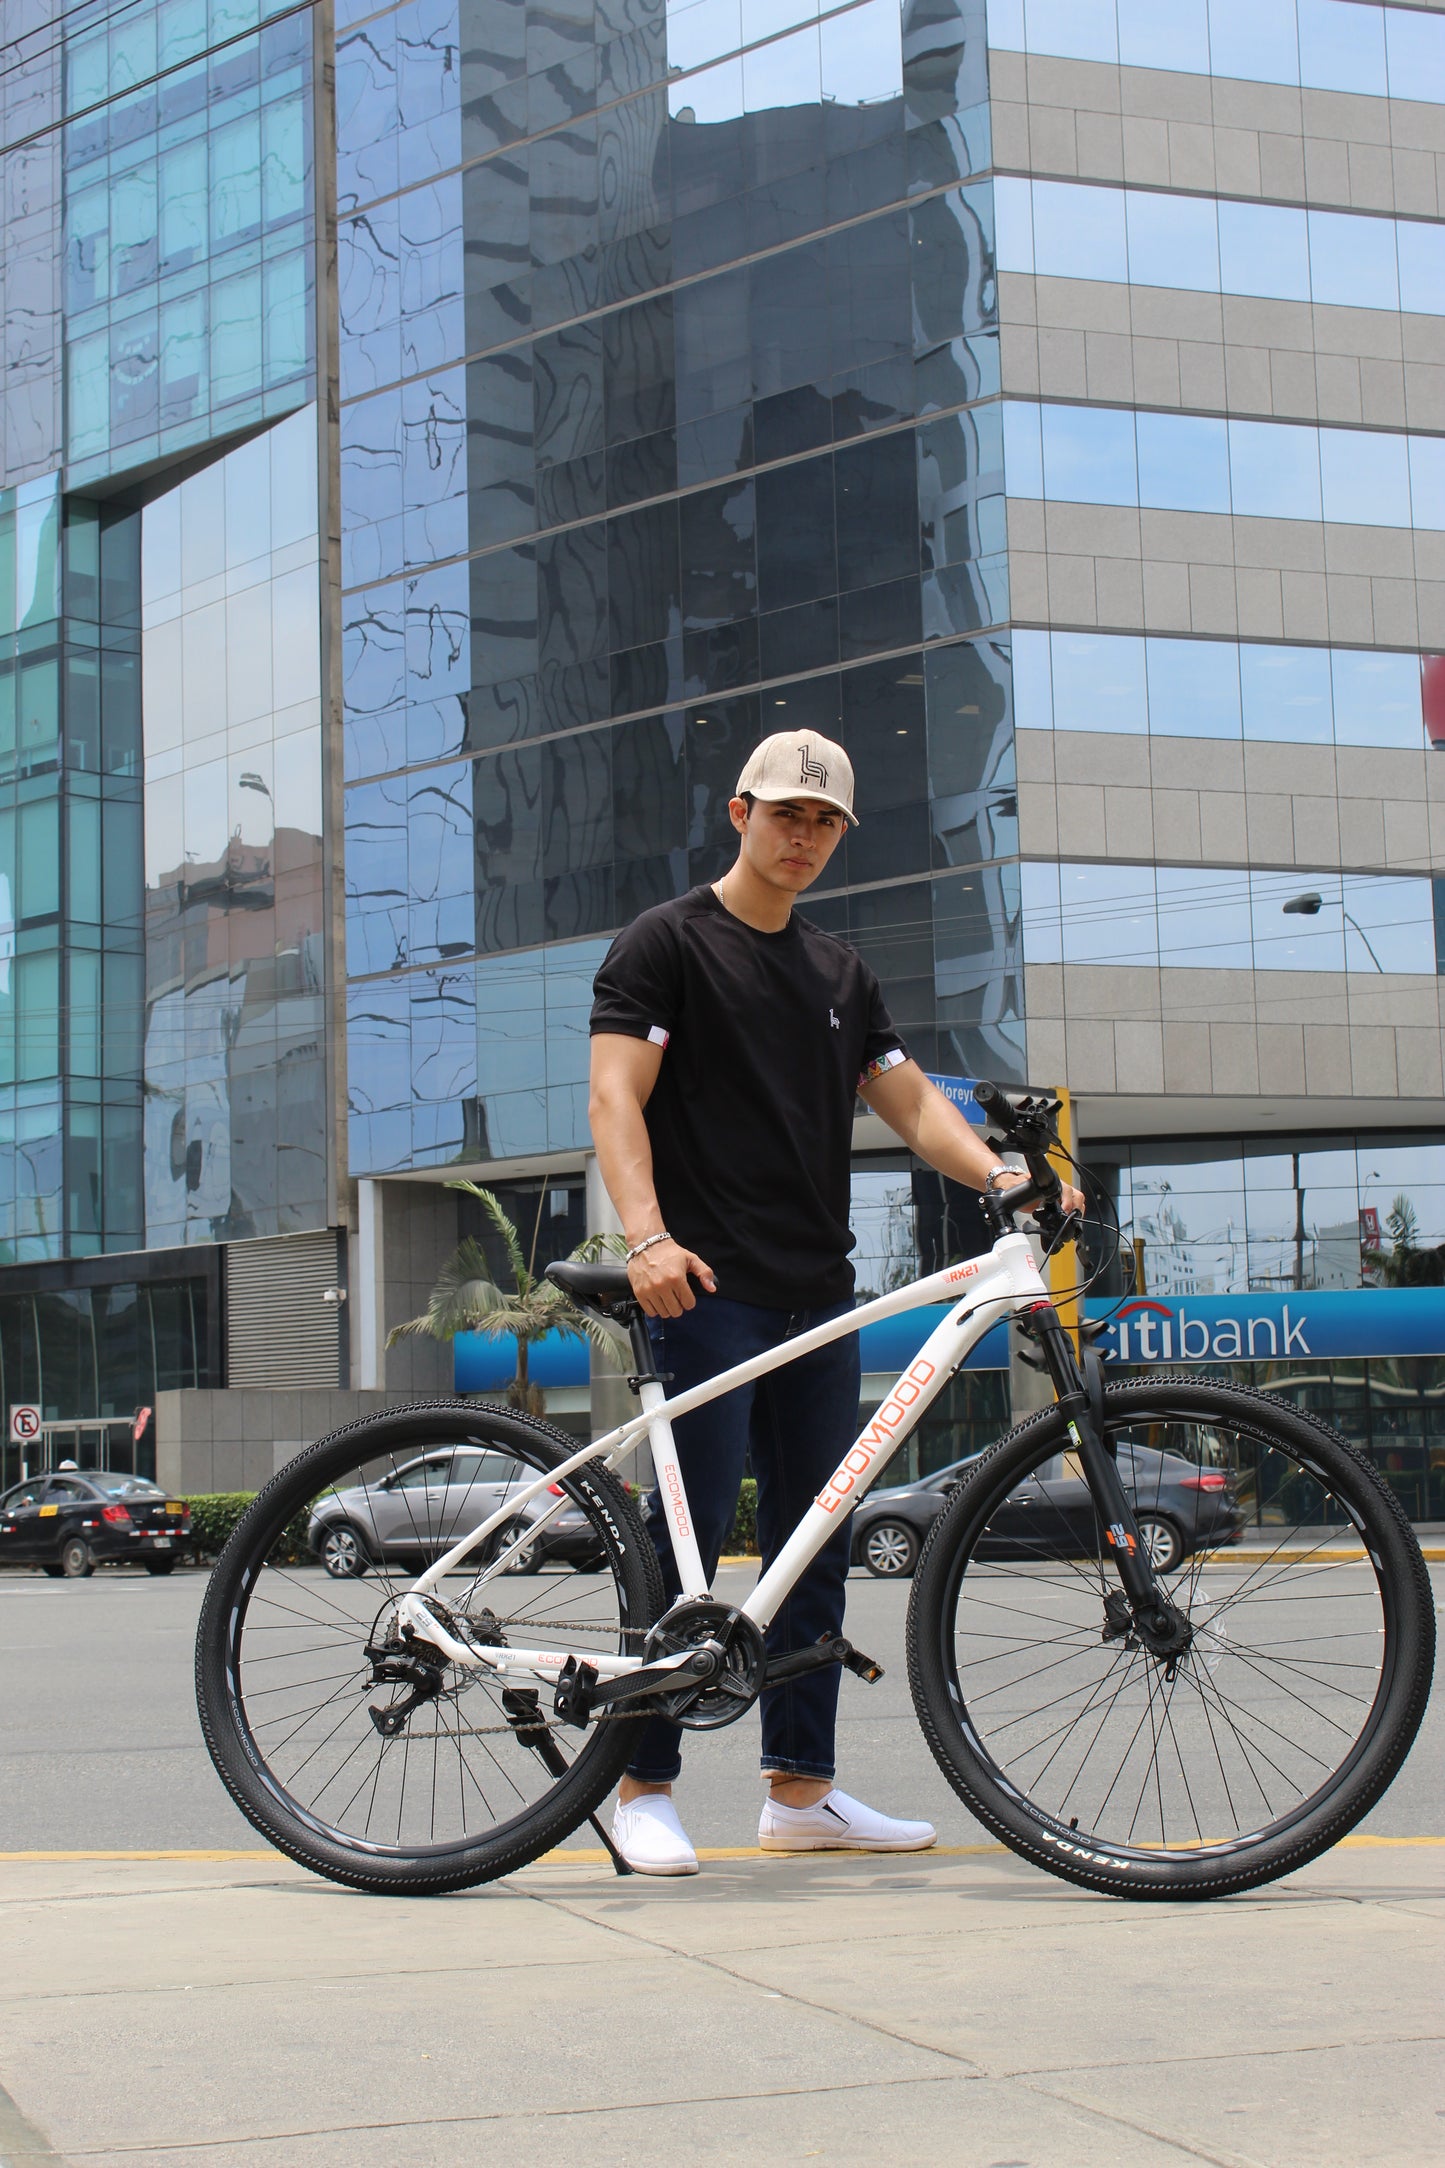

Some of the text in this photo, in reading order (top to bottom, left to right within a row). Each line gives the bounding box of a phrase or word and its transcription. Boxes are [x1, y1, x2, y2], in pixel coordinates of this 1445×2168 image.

[949, 1263, 980, 1283] RX21
[815, 1359, 936, 1514] ECOMOOD
[1228, 1419, 1299, 1457] ECOMOOD
[580, 1480, 626, 1556] KENDA
[664, 1464, 690, 1537] ECOMOOD
[231, 1700, 259, 1767] ECOMOOD
[1022, 1801, 1092, 1845] ECOMOOD
[1041, 1830, 1131, 1869] KENDA
